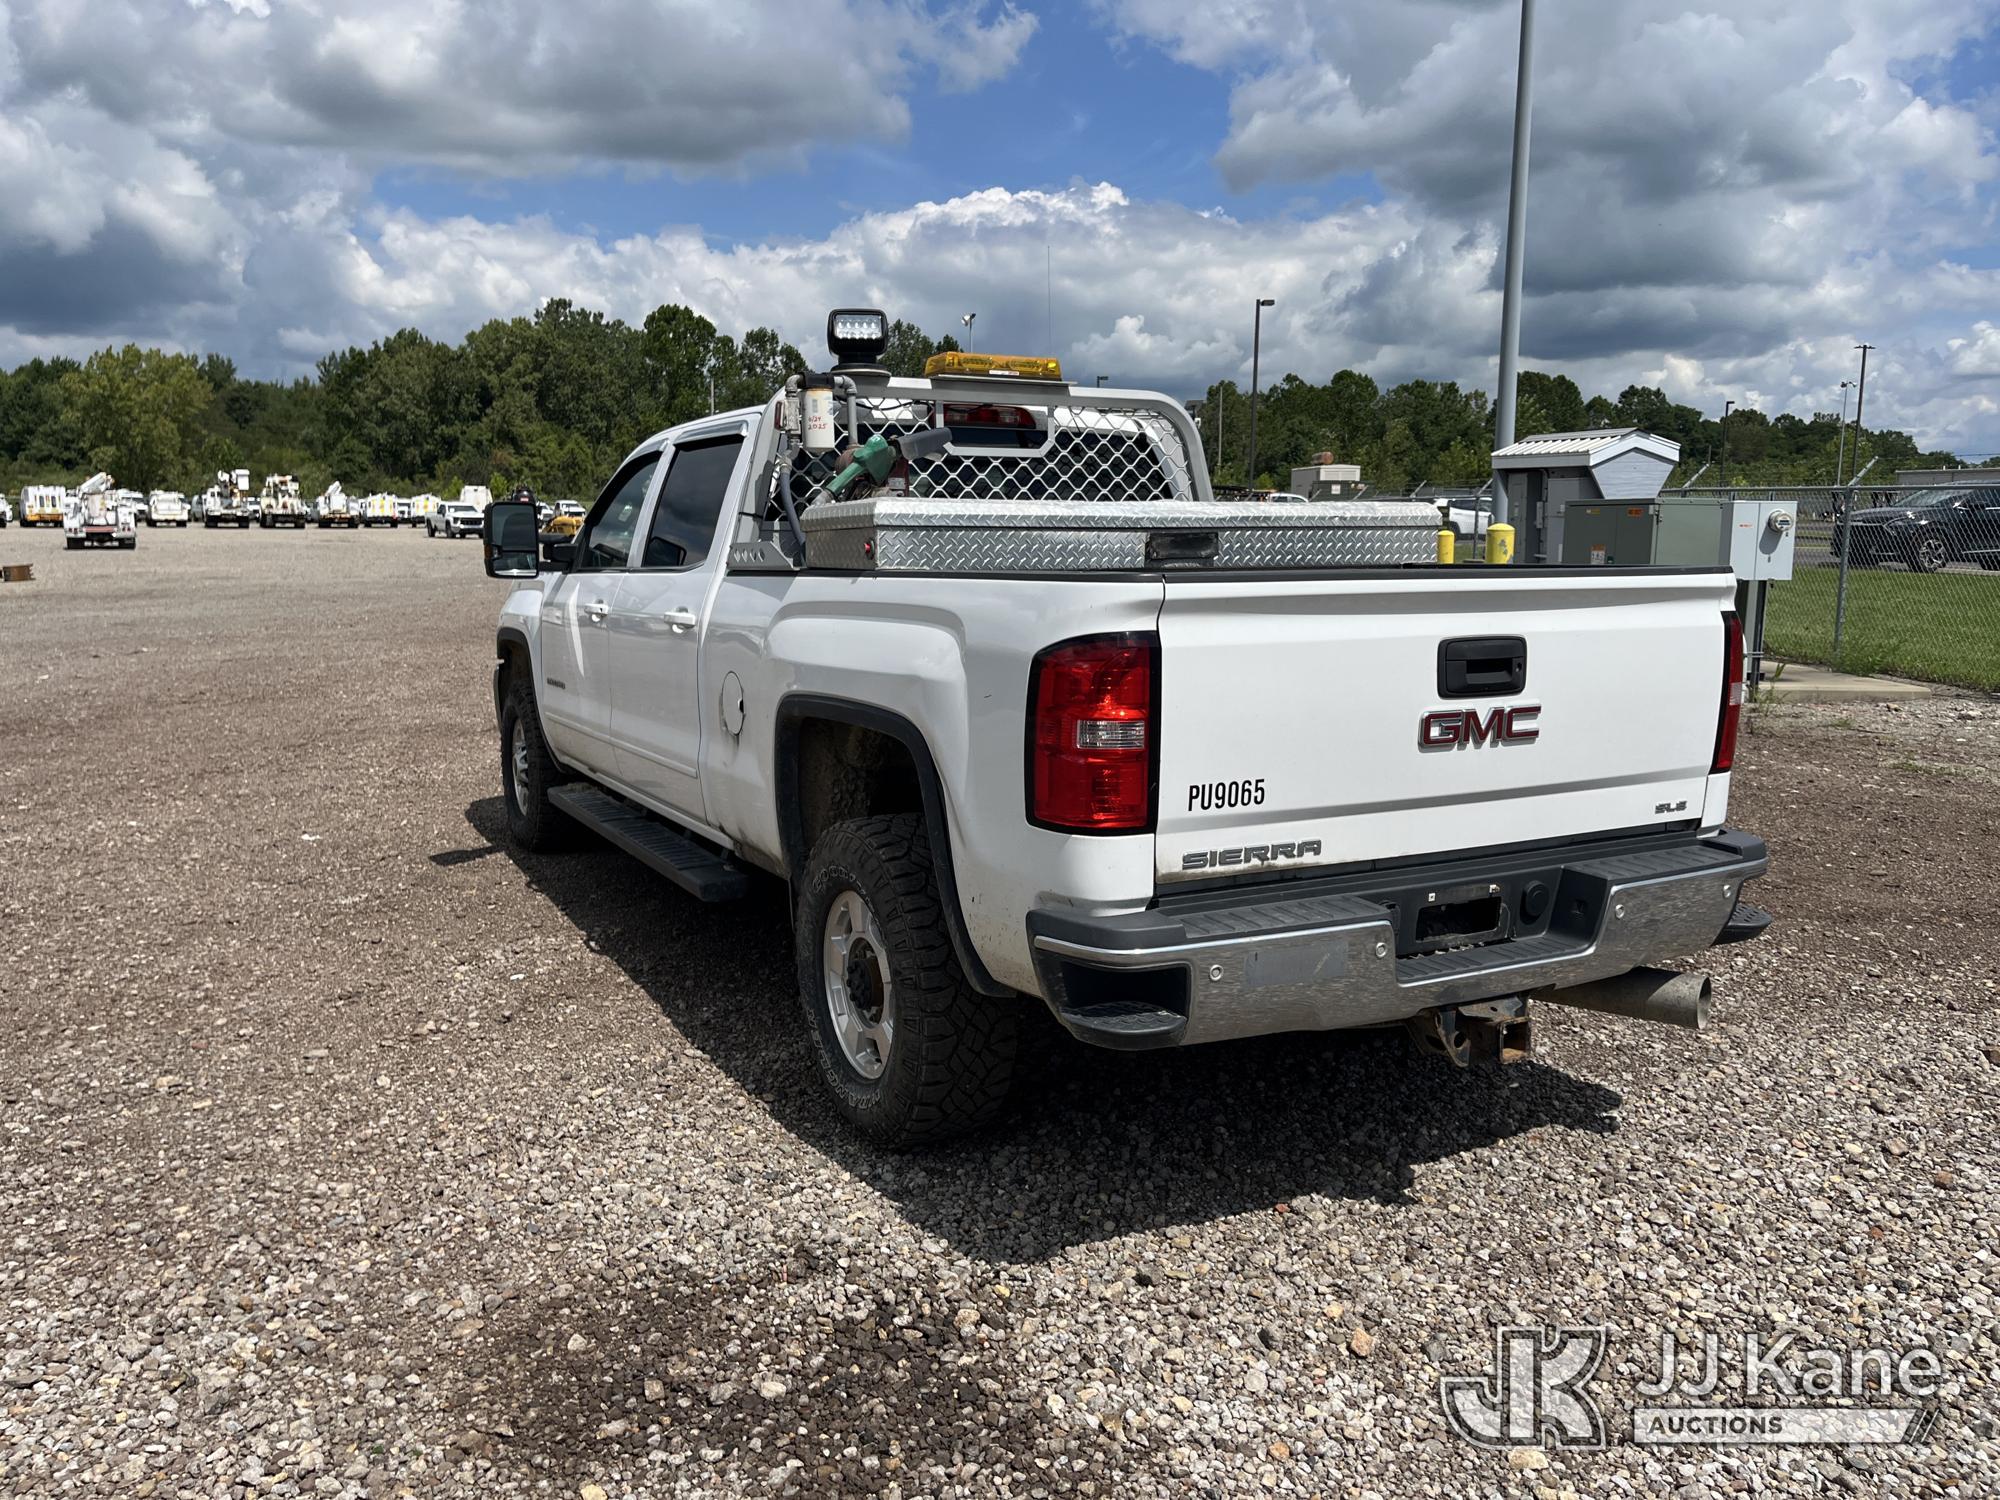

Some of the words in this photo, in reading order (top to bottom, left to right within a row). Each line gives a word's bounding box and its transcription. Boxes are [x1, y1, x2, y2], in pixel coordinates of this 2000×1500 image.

[1418, 704, 1541, 753] GMC
[1188, 778, 1265, 811] PU9065
[1182, 839, 1322, 870] SIERRA
